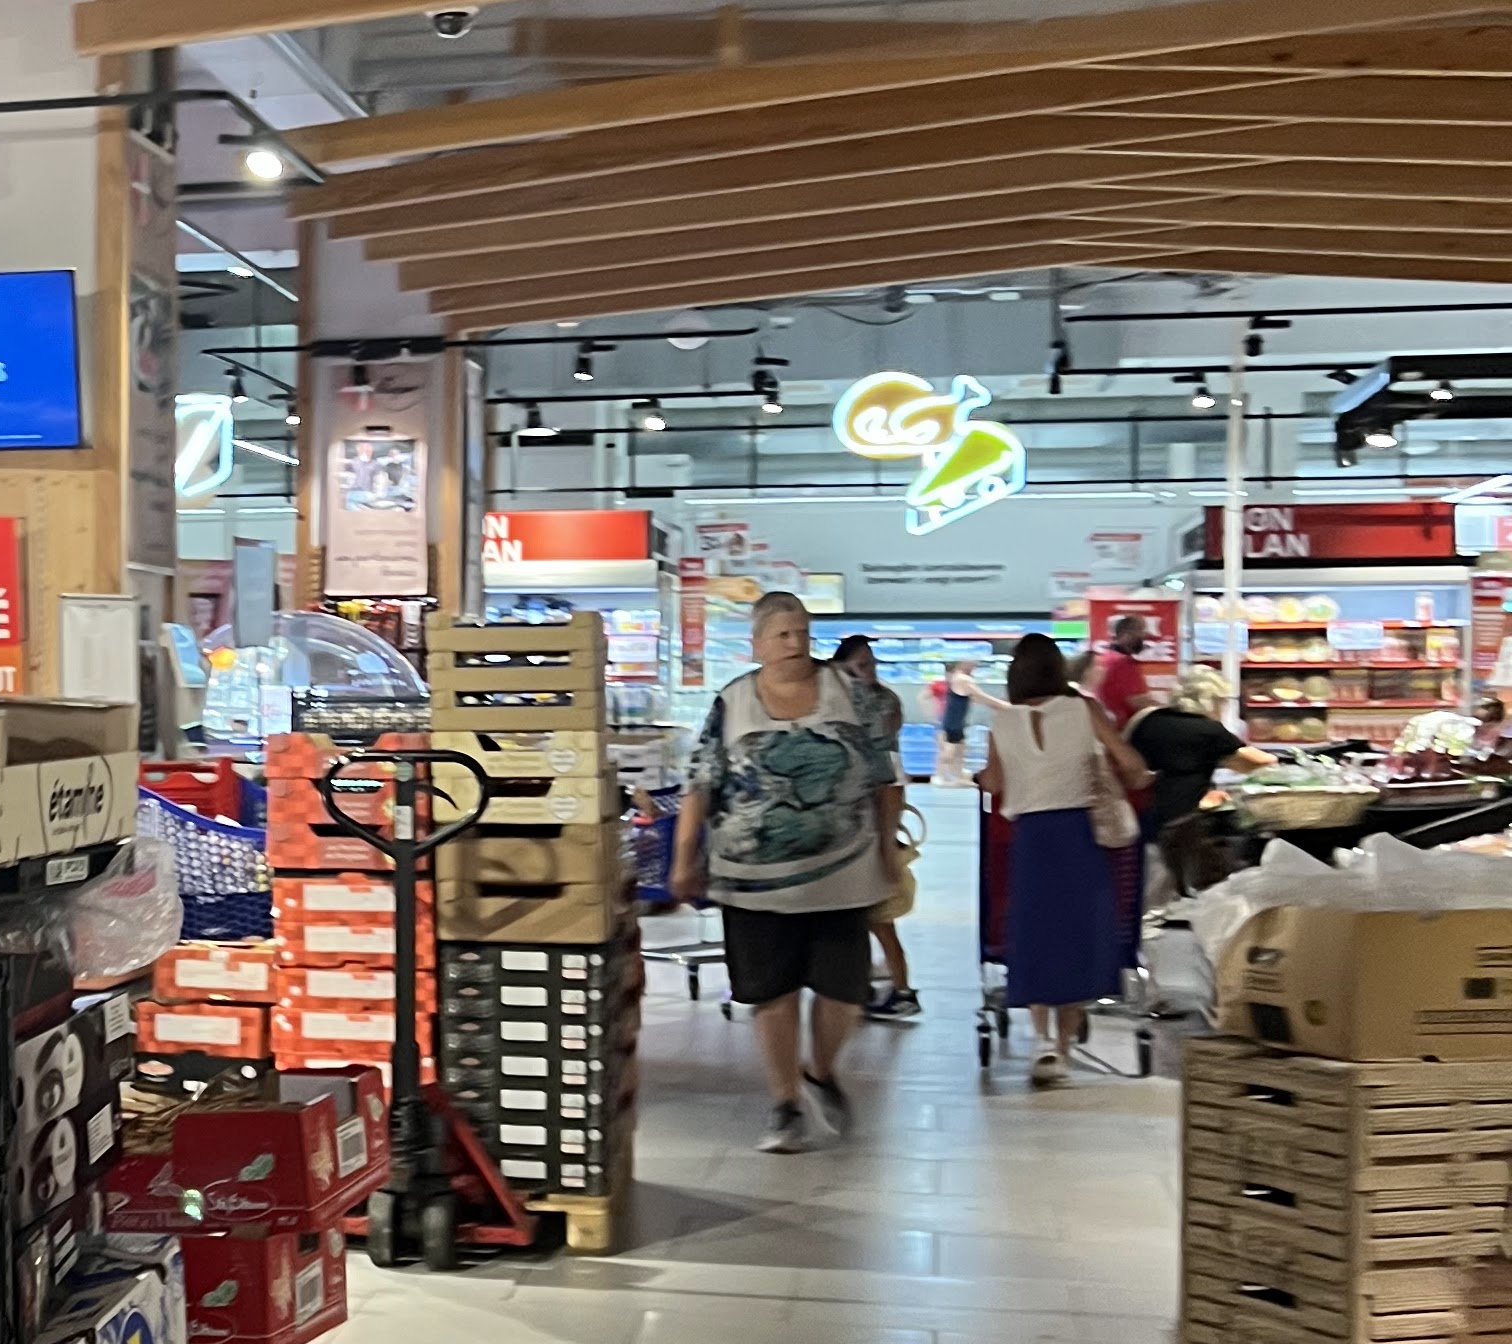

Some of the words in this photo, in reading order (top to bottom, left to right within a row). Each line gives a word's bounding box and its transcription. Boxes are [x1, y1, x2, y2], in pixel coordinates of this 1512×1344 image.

[1243, 508, 1294, 532] ON
[481, 540, 523, 563] AN
[1244, 534, 1311, 558] LAN
